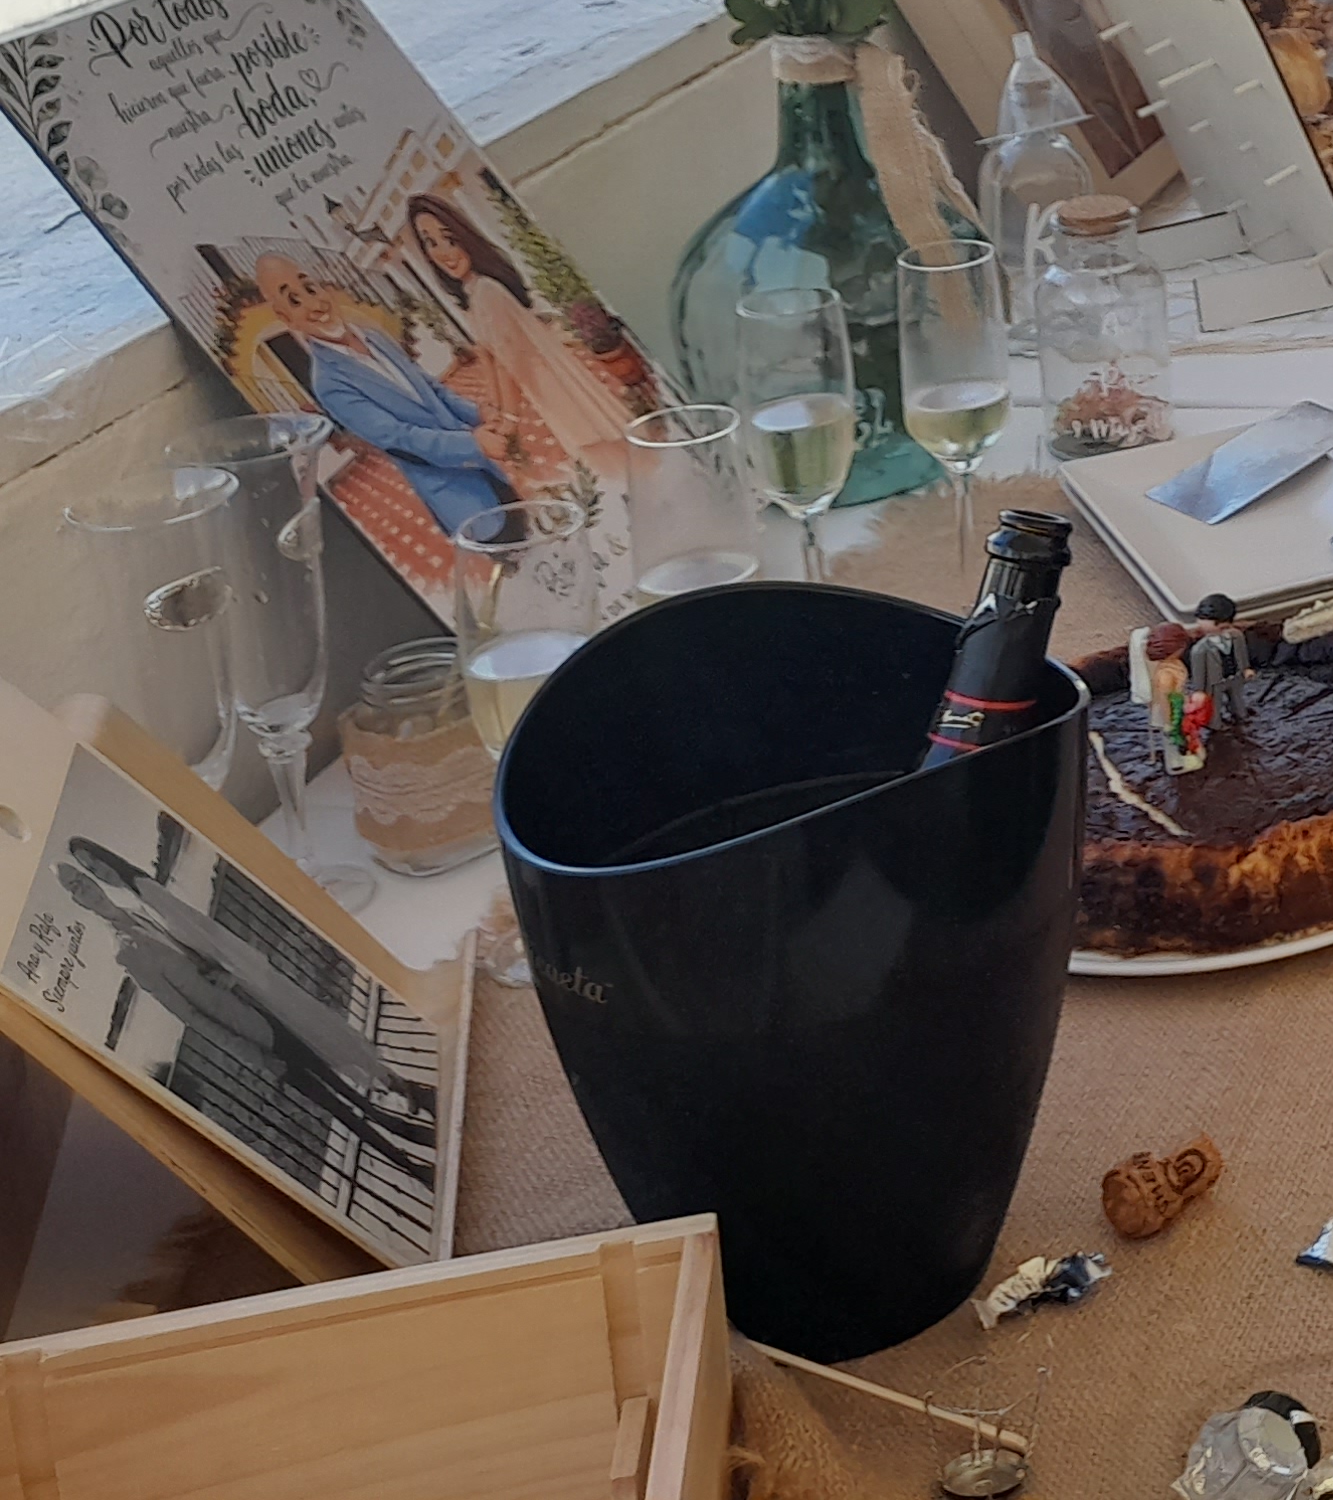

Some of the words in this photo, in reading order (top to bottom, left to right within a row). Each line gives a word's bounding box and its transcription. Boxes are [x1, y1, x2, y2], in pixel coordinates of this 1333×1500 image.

[88, 10, 167, 76] Por
[228, 19, 309, 95] posible
[166, 176, 192, 214] por
[184, 153, 225, 185] todas
[215, 140, 245, 164] las
[253, 118, 337, 178] uniones
[29, 912, 62, 947] Rafa
[33, 942, 53, 959] y
[16, 953, 41, 985] Ana
[42, 957, 80, 1013] Siempre
[66, 920, 87, 969] juntos
